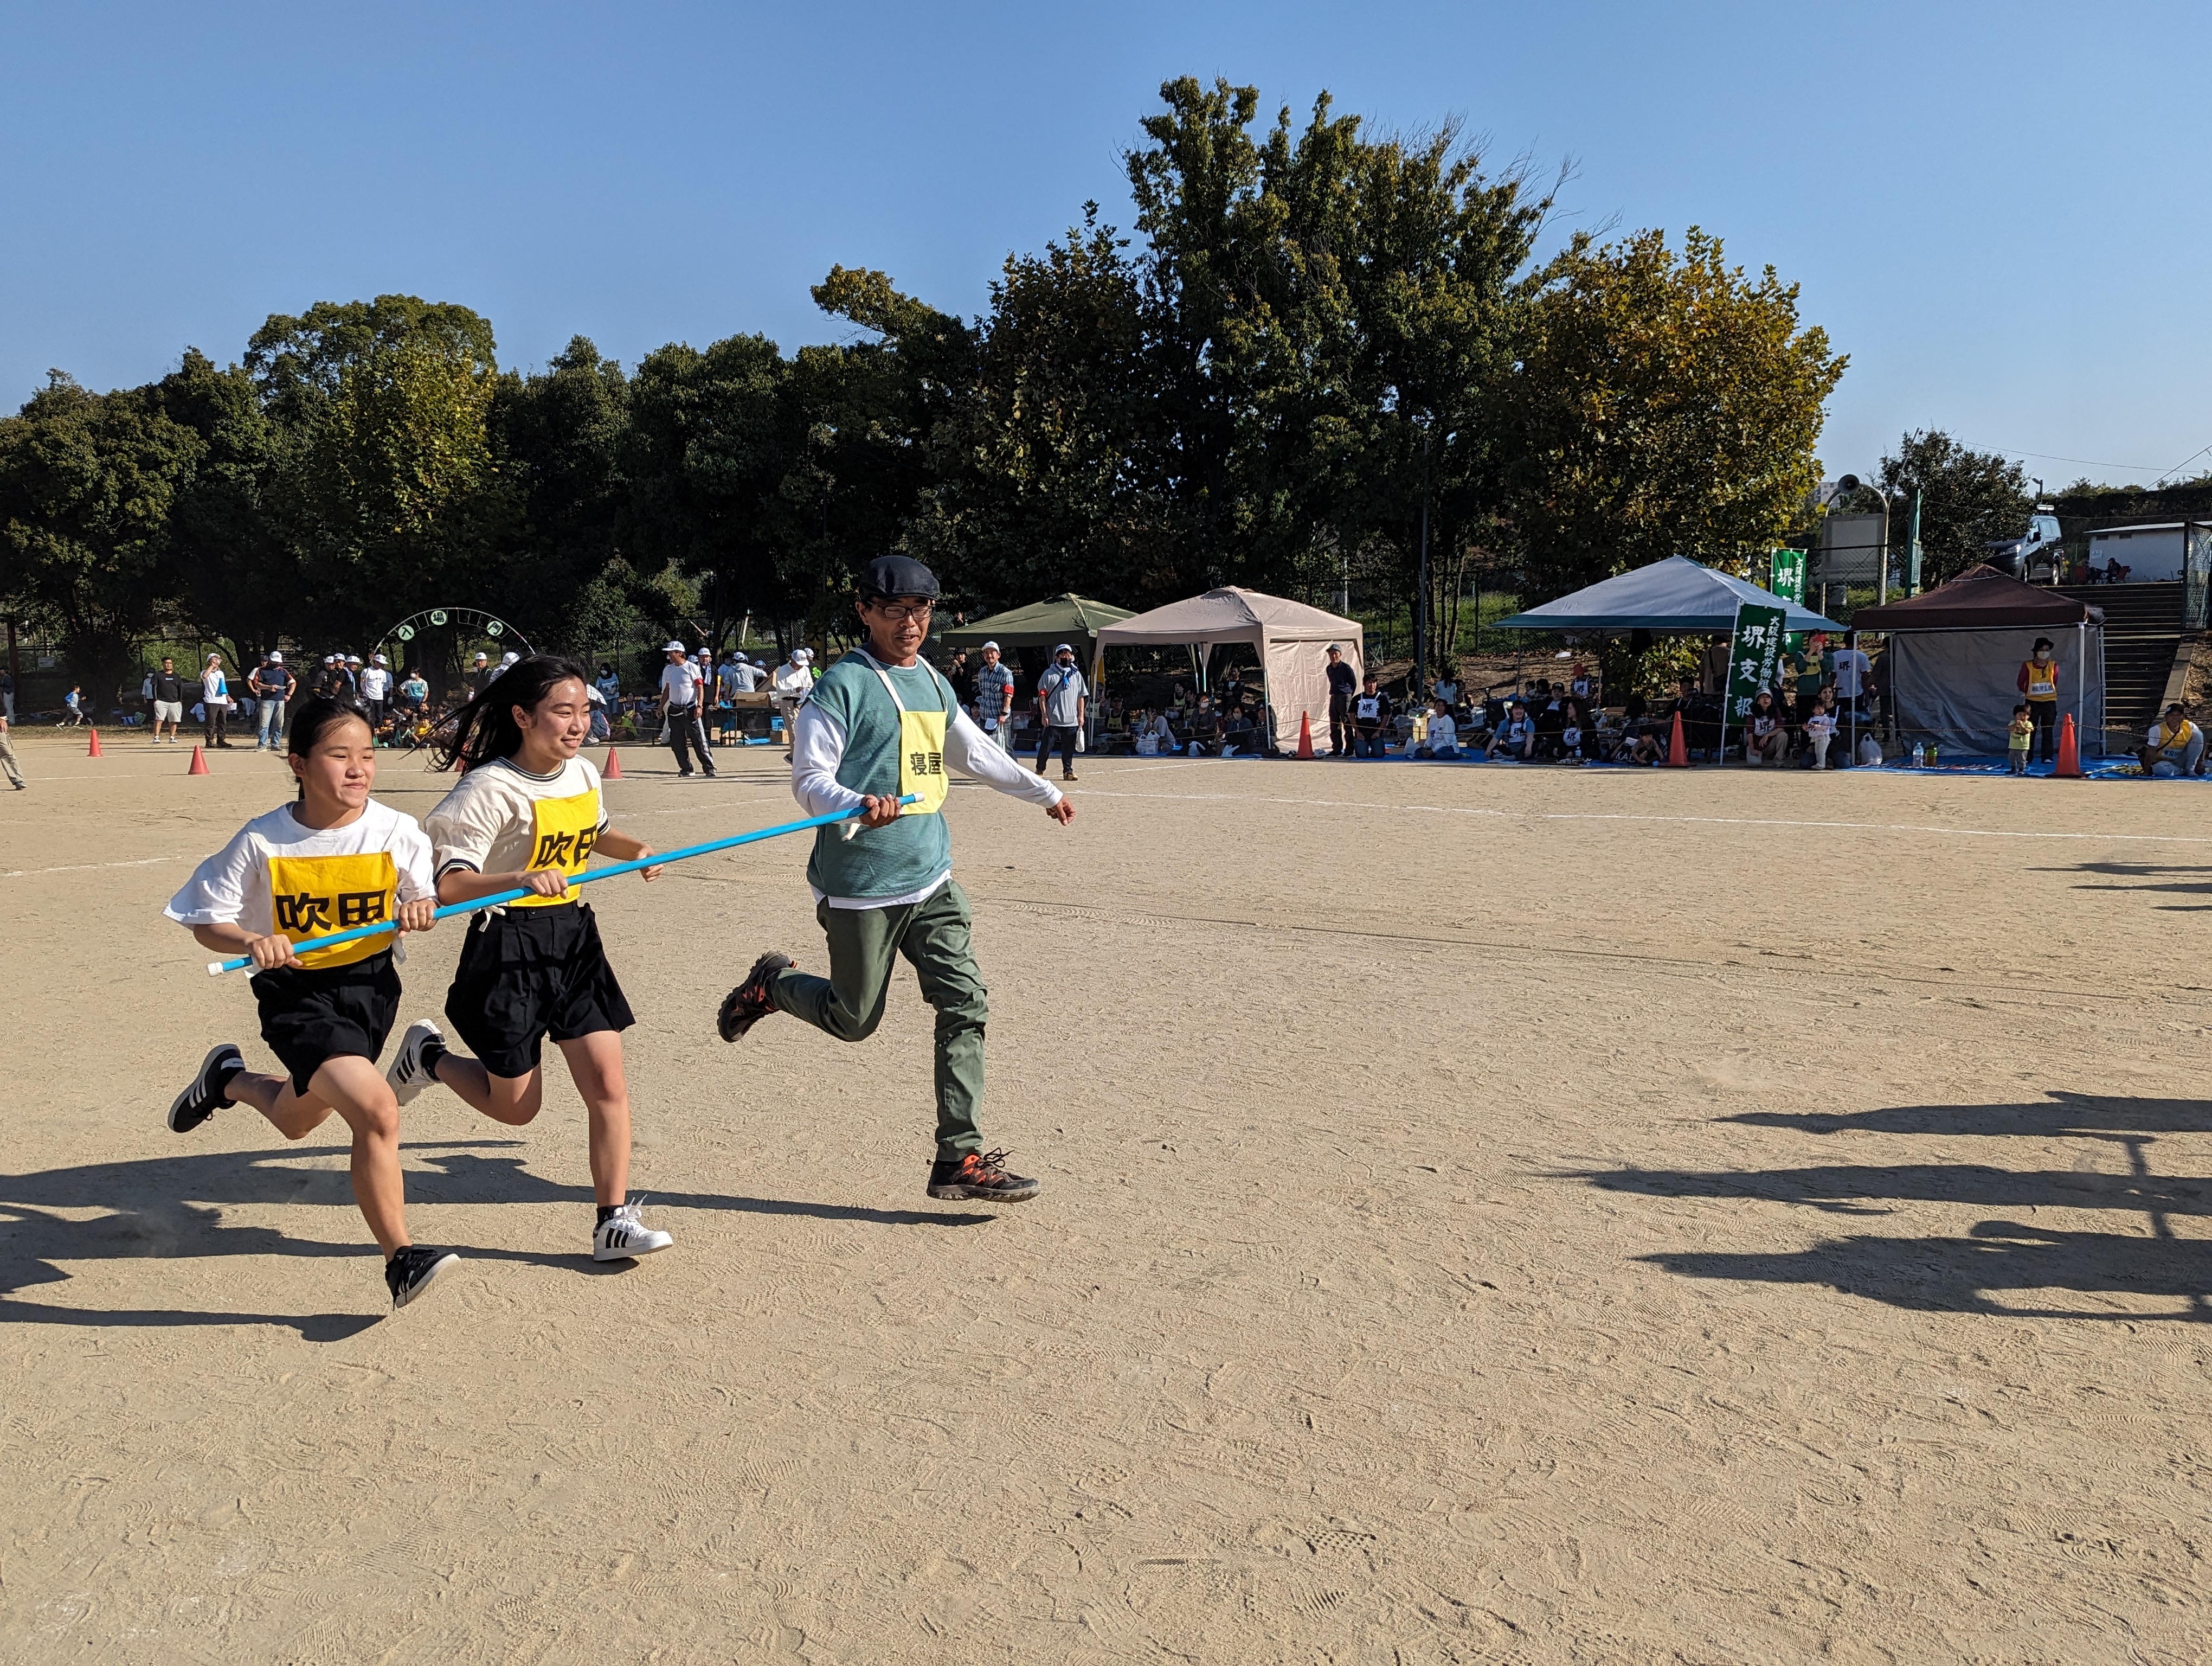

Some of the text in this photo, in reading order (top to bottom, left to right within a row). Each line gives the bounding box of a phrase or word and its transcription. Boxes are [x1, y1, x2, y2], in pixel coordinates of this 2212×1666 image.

[401, 612, 501, 638] 入場門
[1734, 625, 1766, 719] 堺支部
[1838, 661, 1850, 671] 堺
[1362, 703, 1373, 713] 堺
[1759, 720, 1772, 732] 堺
[910, 752, 942, 776] 寝屋
[533, 823, 597, 869] 吹田
[275, 888, 387, 934] 吹田
